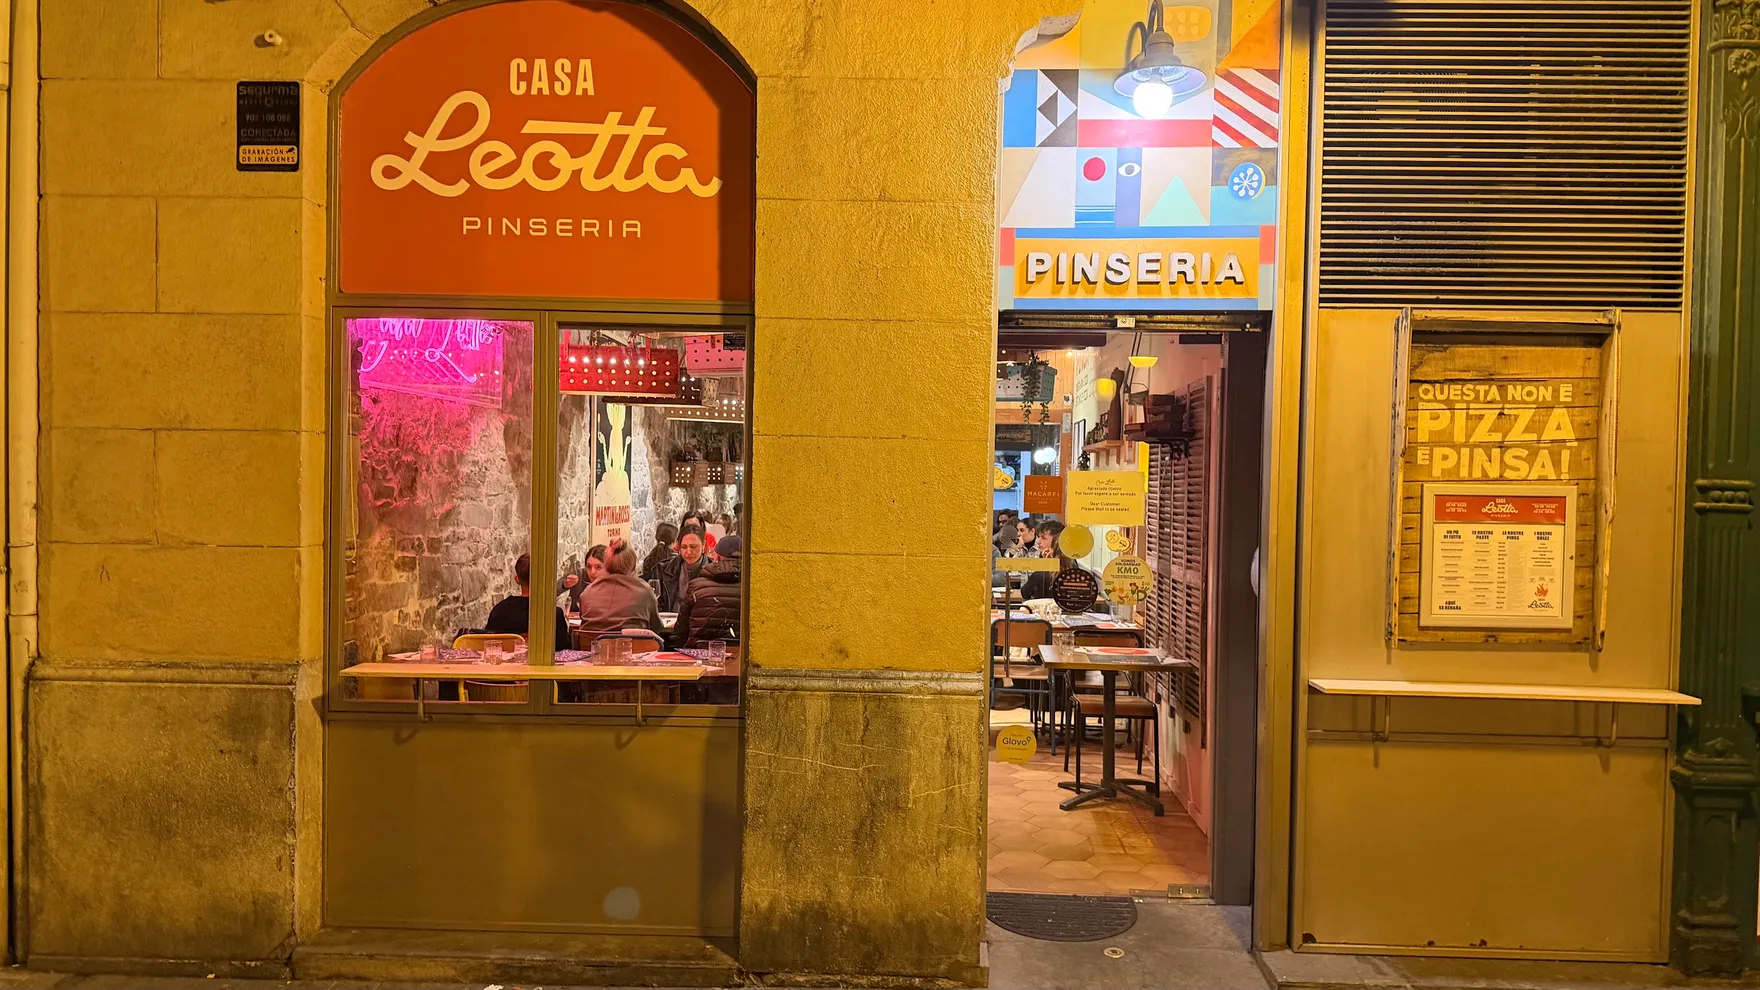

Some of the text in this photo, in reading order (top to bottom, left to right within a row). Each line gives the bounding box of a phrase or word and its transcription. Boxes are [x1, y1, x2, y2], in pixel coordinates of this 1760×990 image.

[509, 57, 595, 96] CASA
[242, 147, 284, 155] GRABACIÓN
[370, 90, 724, 198] Leotta
[254, 155, 295, 163] IMÁGENES
[462, 216, 642, 238] PINSERIA
[1025, 252, 1245, 285] PINSERIA
[1418, 383, 1501, 401] QUESTA
[1507, 384, 1553, 402] NON
[1417, 402, 1578, 447] PIZZA
[1431, 447, 1571, 482] PINSA!
[1481, 501, 1519, 514] Leotta
